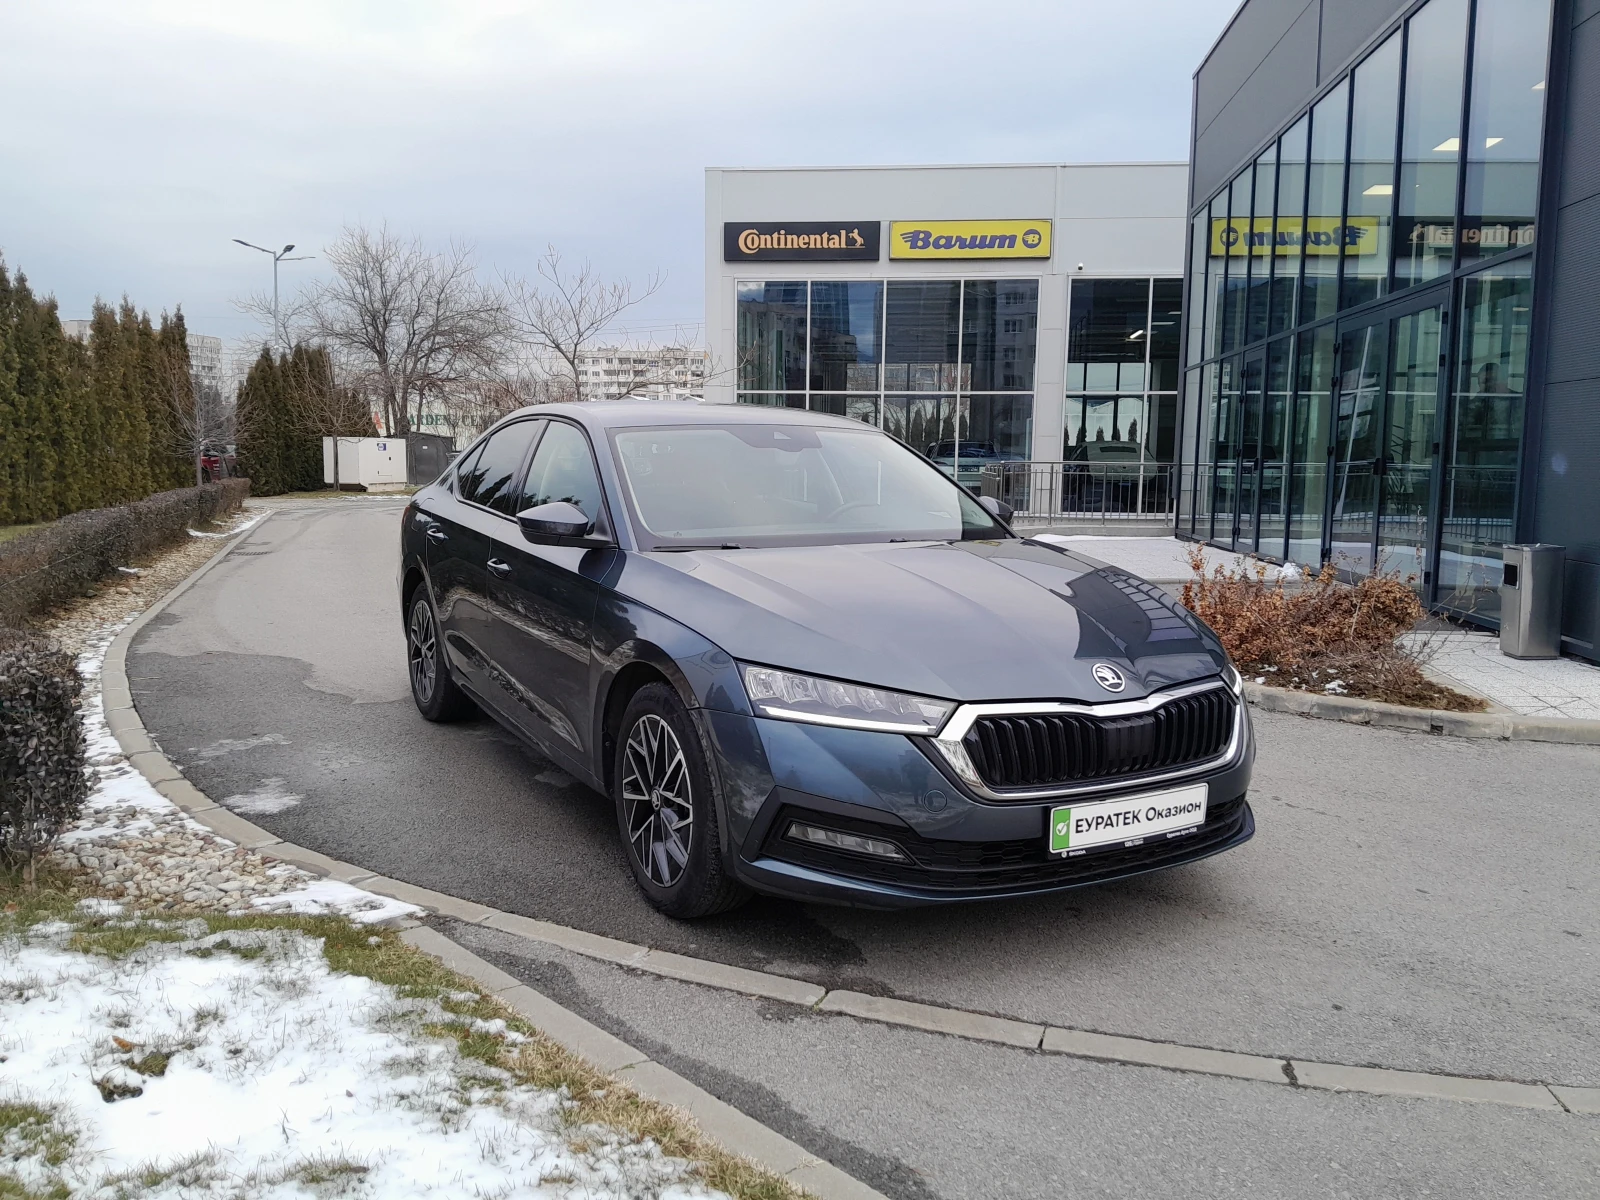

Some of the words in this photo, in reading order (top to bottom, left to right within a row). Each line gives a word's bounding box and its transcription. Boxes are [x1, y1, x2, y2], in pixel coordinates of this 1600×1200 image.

[738, 228, 848, 254] Continental
[900, 230, 1018, 250] Barum
[1075, 809, 1142, 834] ЕУРАТЕК
[1145, 801, 1202, 821] Оказион
